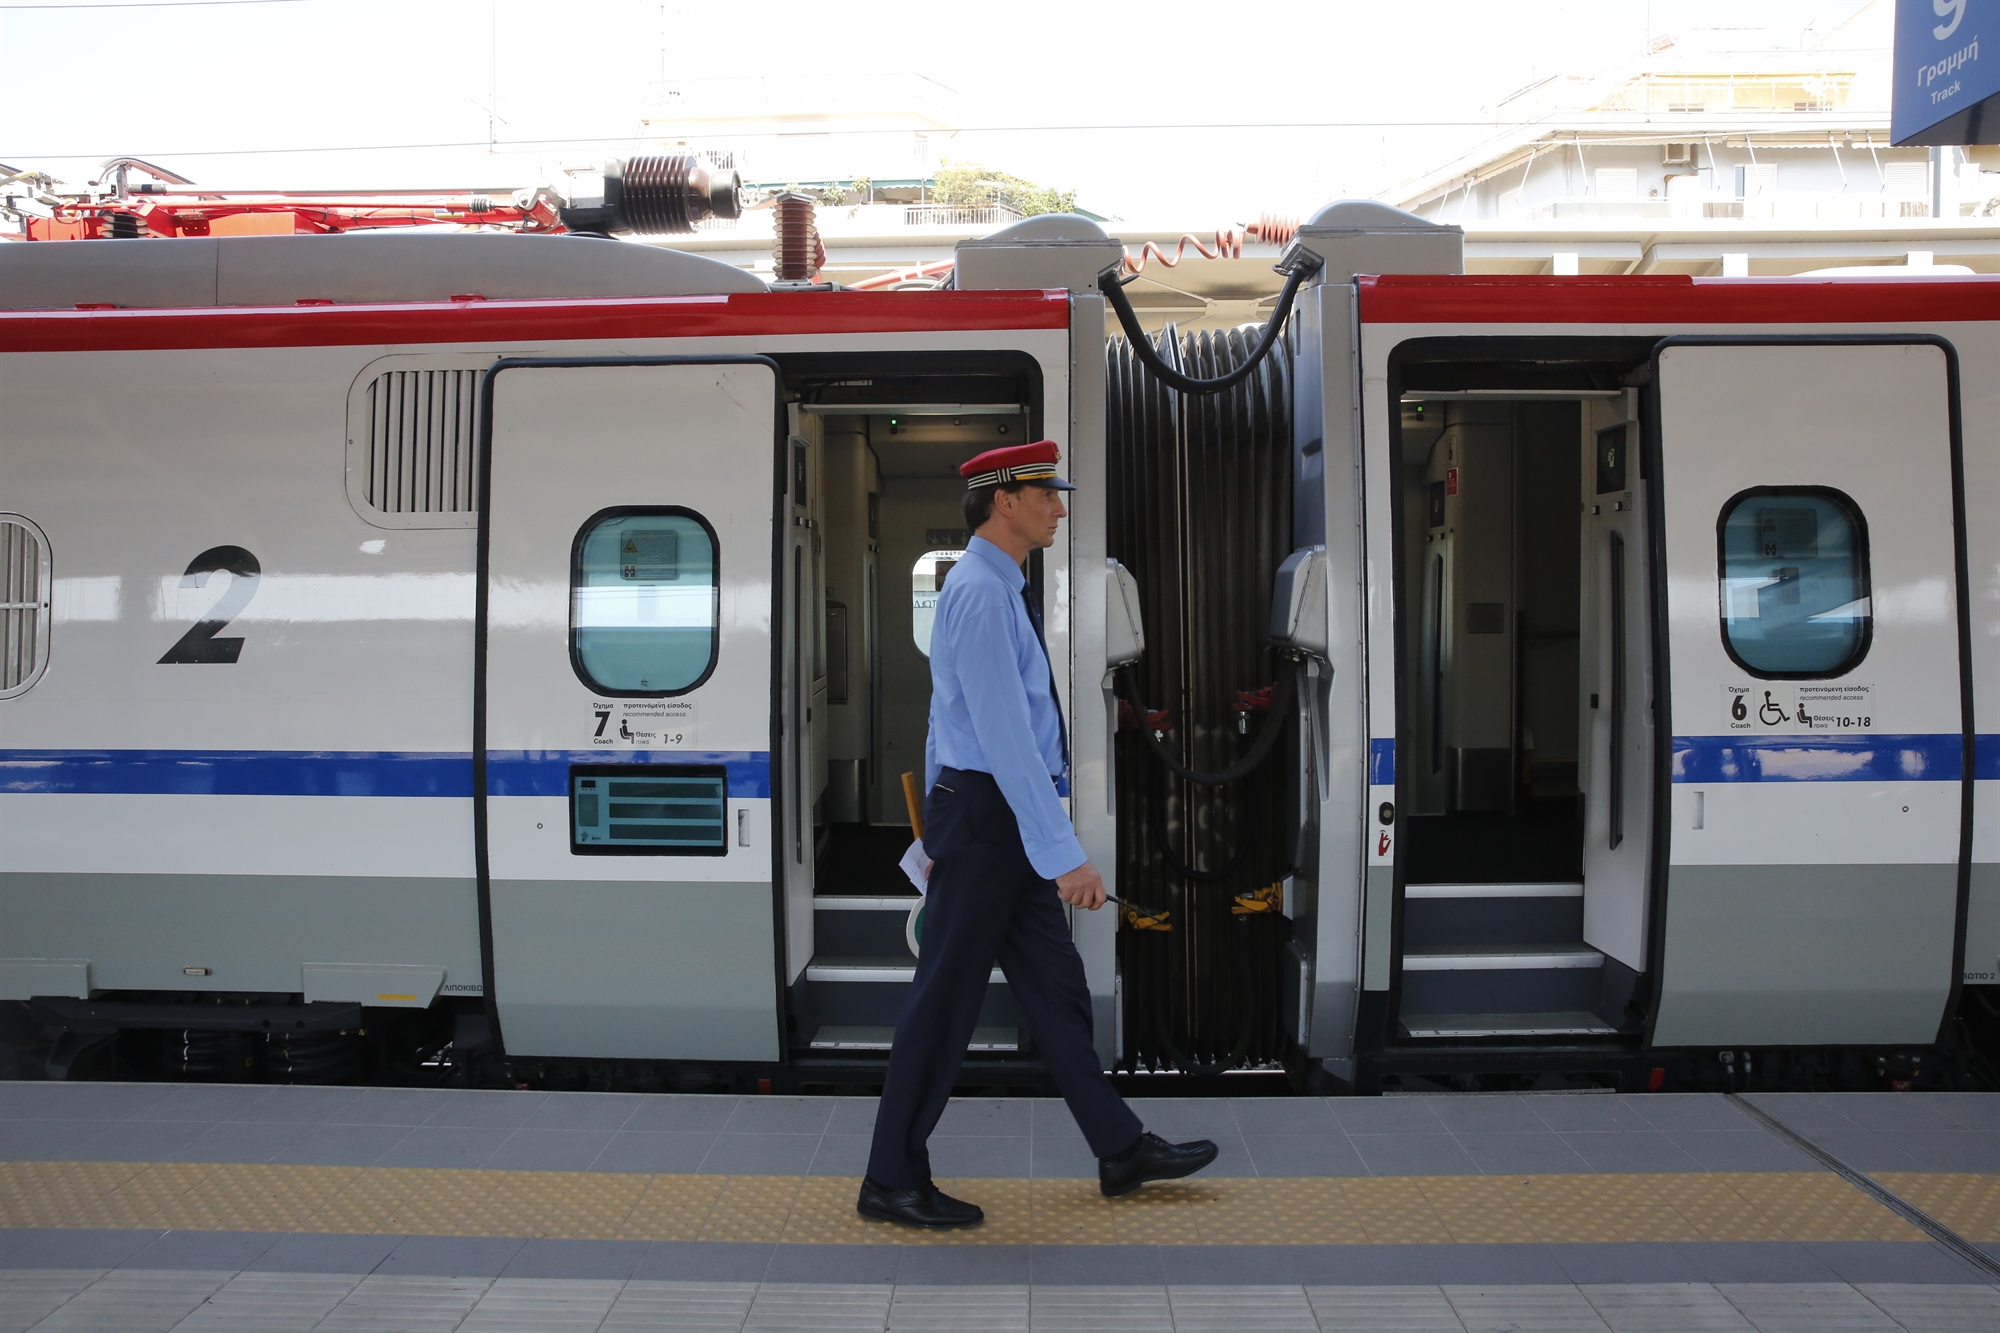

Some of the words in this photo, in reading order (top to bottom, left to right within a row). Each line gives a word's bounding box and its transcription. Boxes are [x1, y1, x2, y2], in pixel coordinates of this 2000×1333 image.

[1933, 0, 1966, 40] 9
[1917, 34, 1978, 87] Γραμμή
[1930, 80, 1961, 105] Track
[156, 545, 261, 664] 2
[1731, 695, 1747, 721] 6
[594, 711, 611, 737] 7
[1836, 716, 1871, 728] 10-18
[663, 733, 683, 744] 1-9
[1990, 972, 1996, 980] 2
